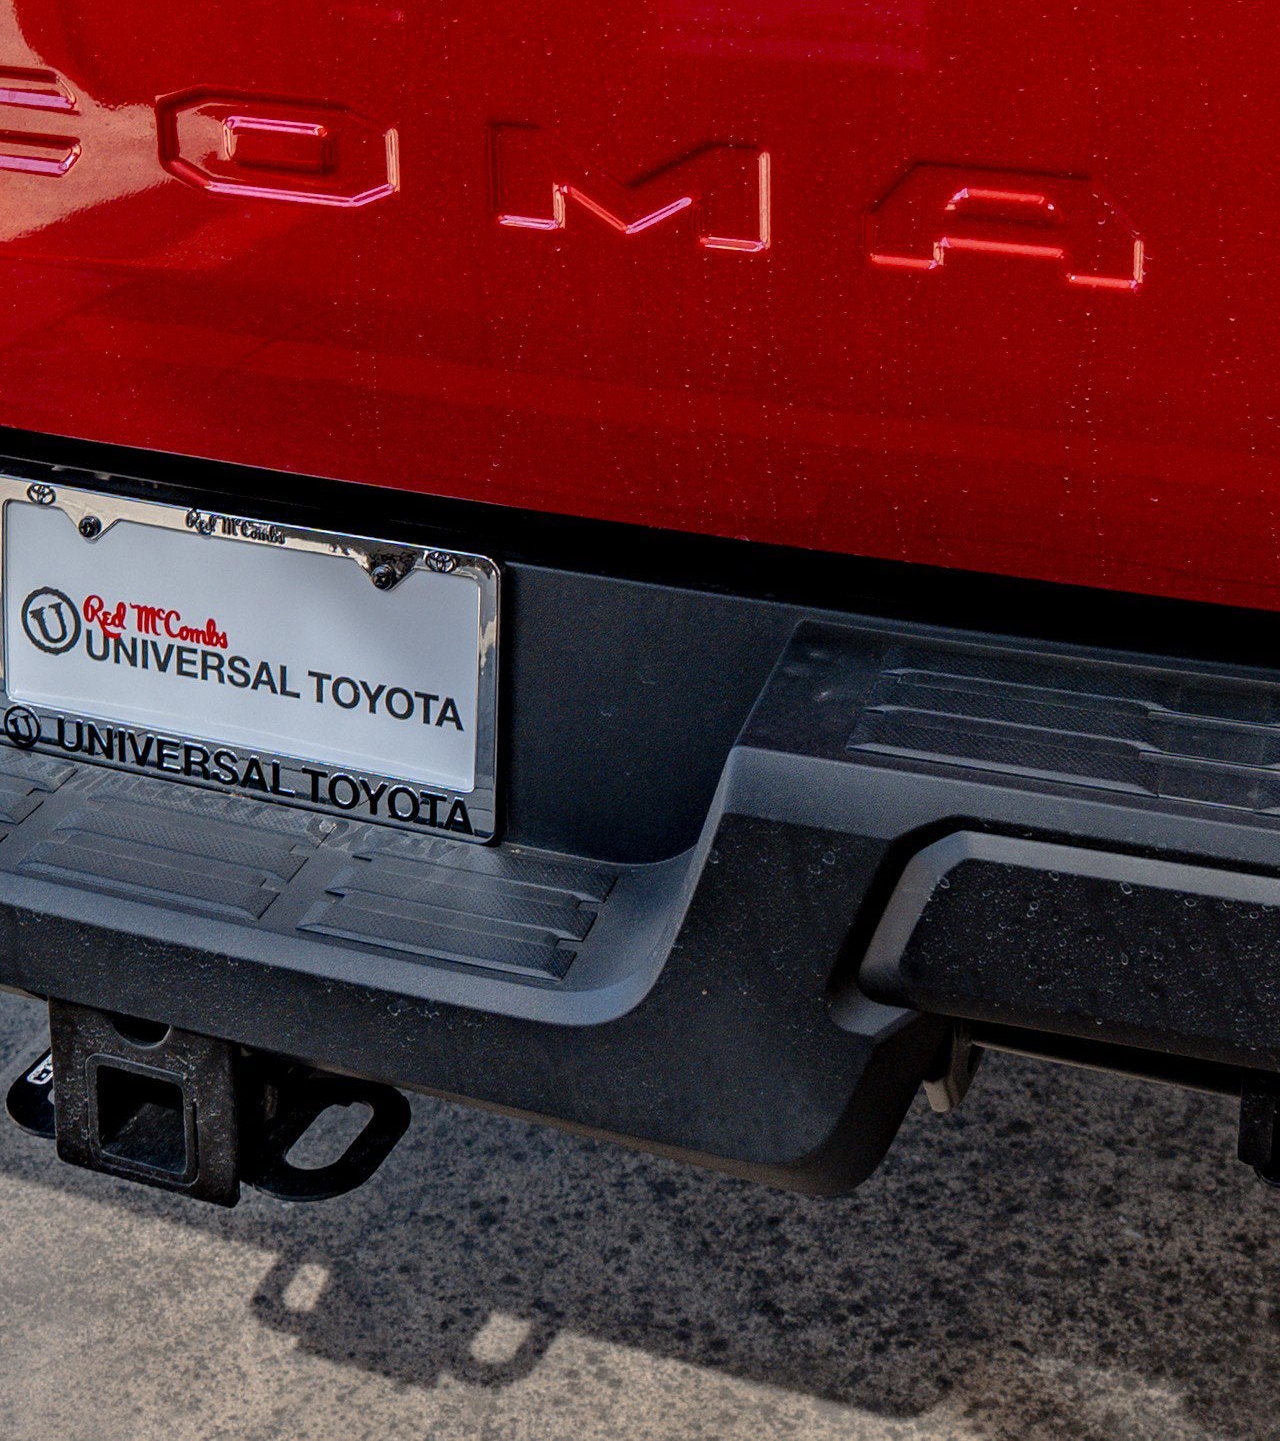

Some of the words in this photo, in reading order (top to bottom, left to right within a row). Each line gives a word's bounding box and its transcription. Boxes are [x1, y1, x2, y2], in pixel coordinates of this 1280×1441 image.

[186, 508, 216, 536] Red
[83, 594, 127, 639] Red
[129, 602, 229, 649] McCombs
[86, 629, 301, 700] UNIVERSAL
[307, 670, 465, 732] TOYOTA
[56, 715, 296, 799] UNIVERSAL
[300, 767, 474, 835] TOYOTA
